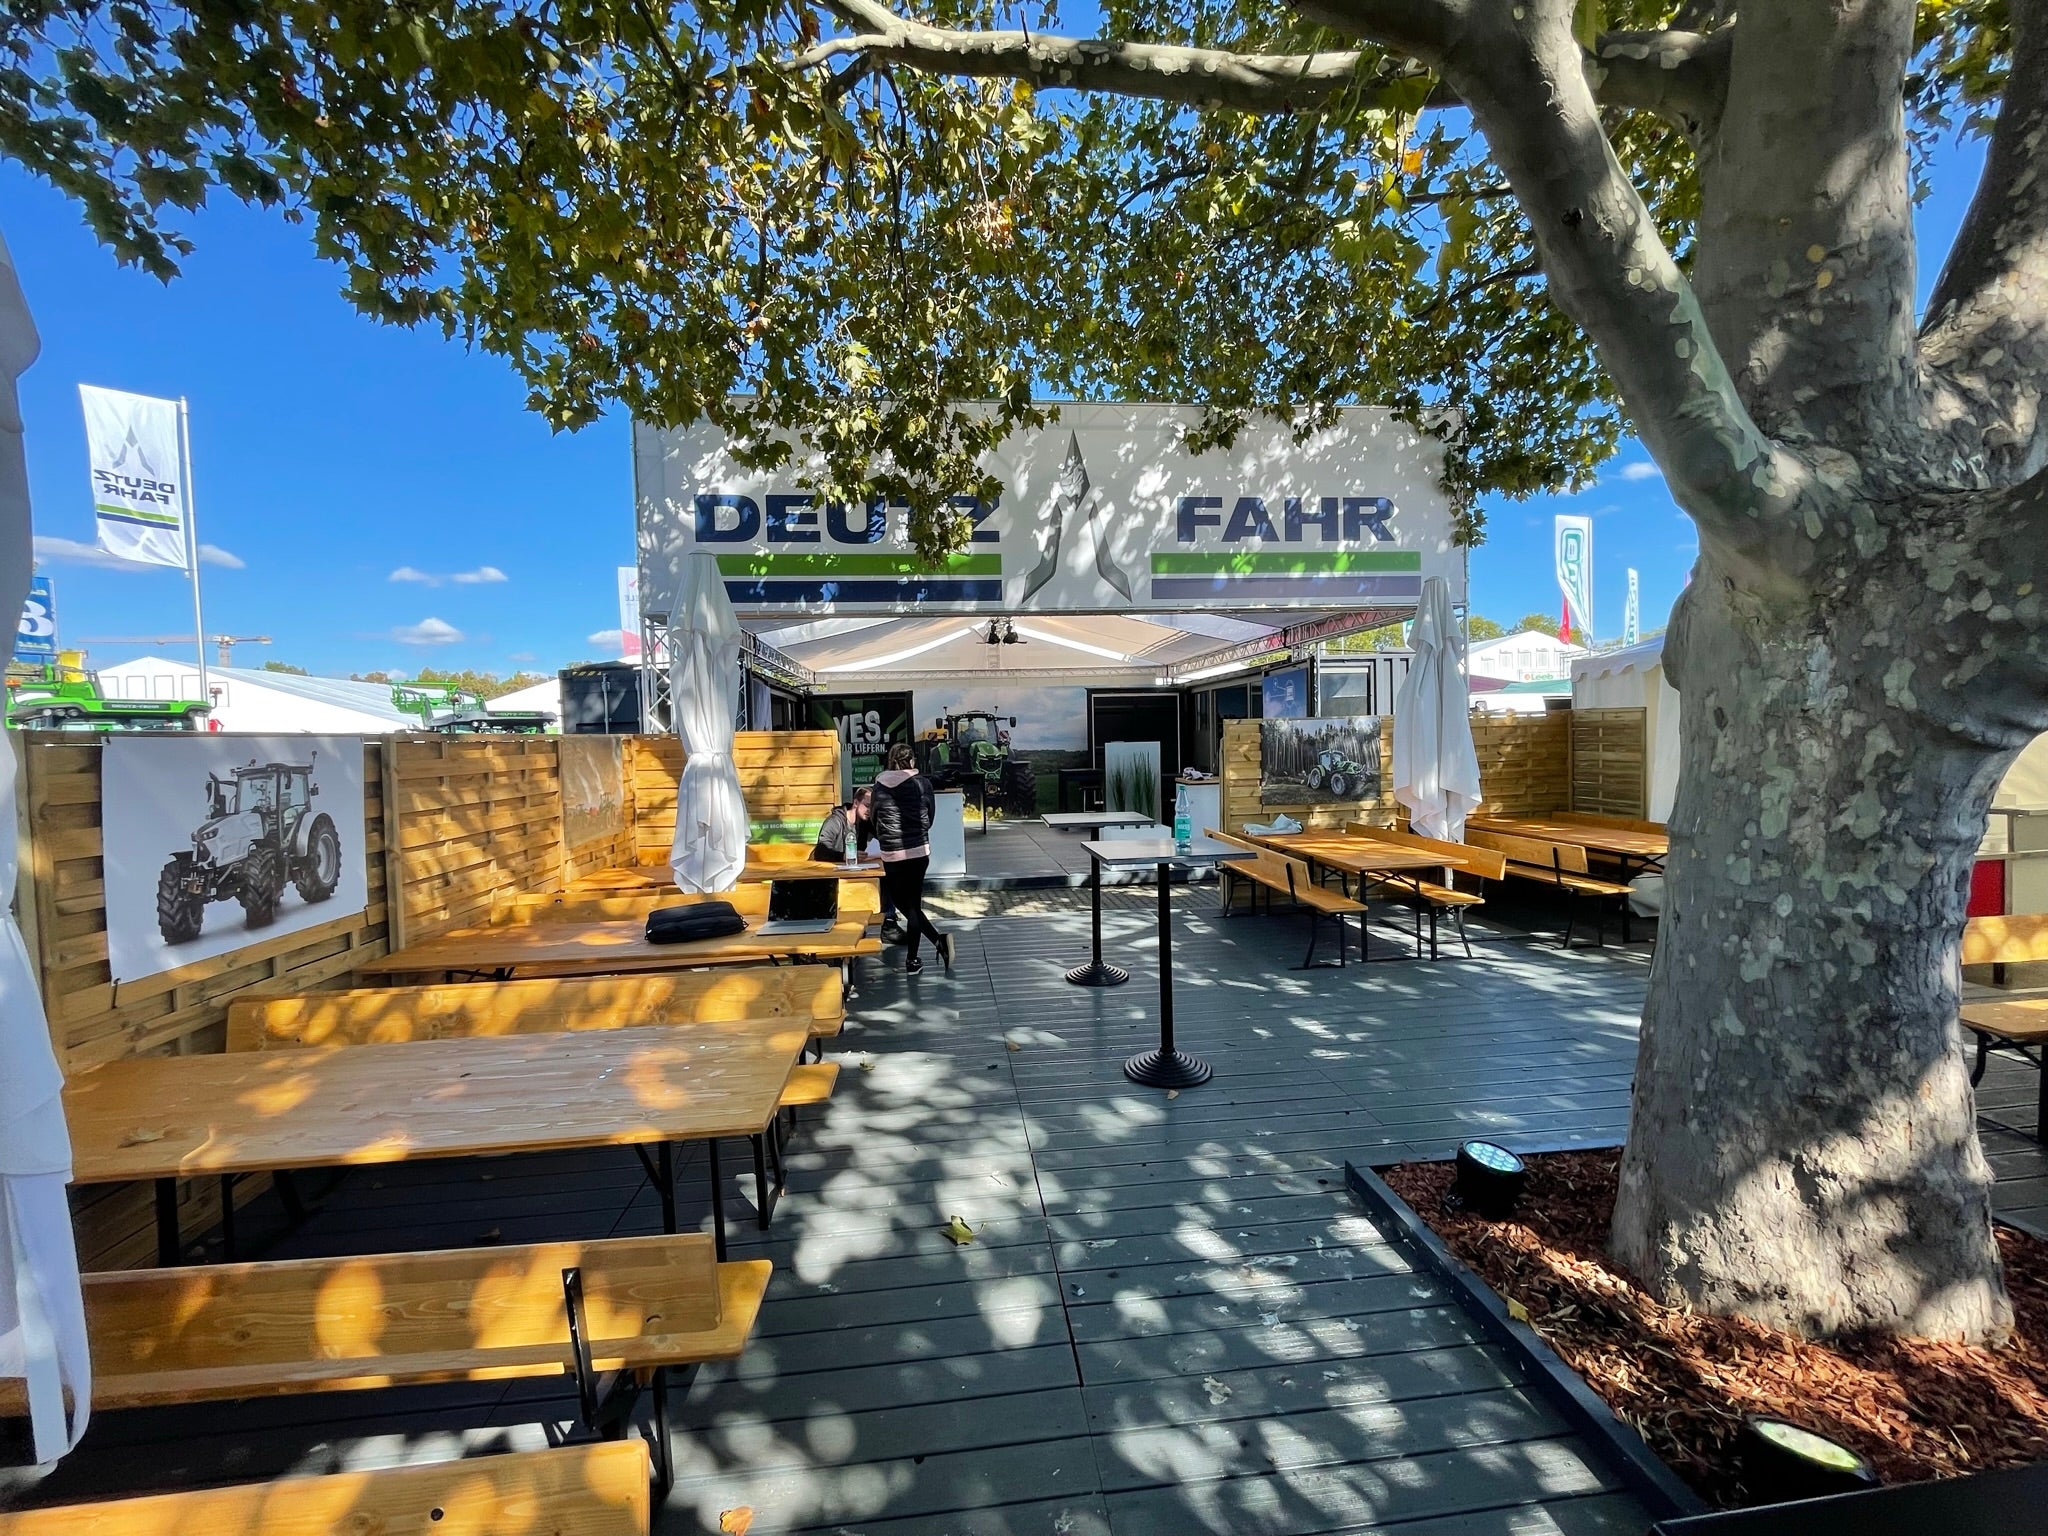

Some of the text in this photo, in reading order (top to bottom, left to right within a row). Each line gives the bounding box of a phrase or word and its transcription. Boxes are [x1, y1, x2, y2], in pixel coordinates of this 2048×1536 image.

[1176, 496, 1396, 542] FAHR
[833, 711, 890, 744] YES.
[855, 743, 888, 753] LIEFERN.
